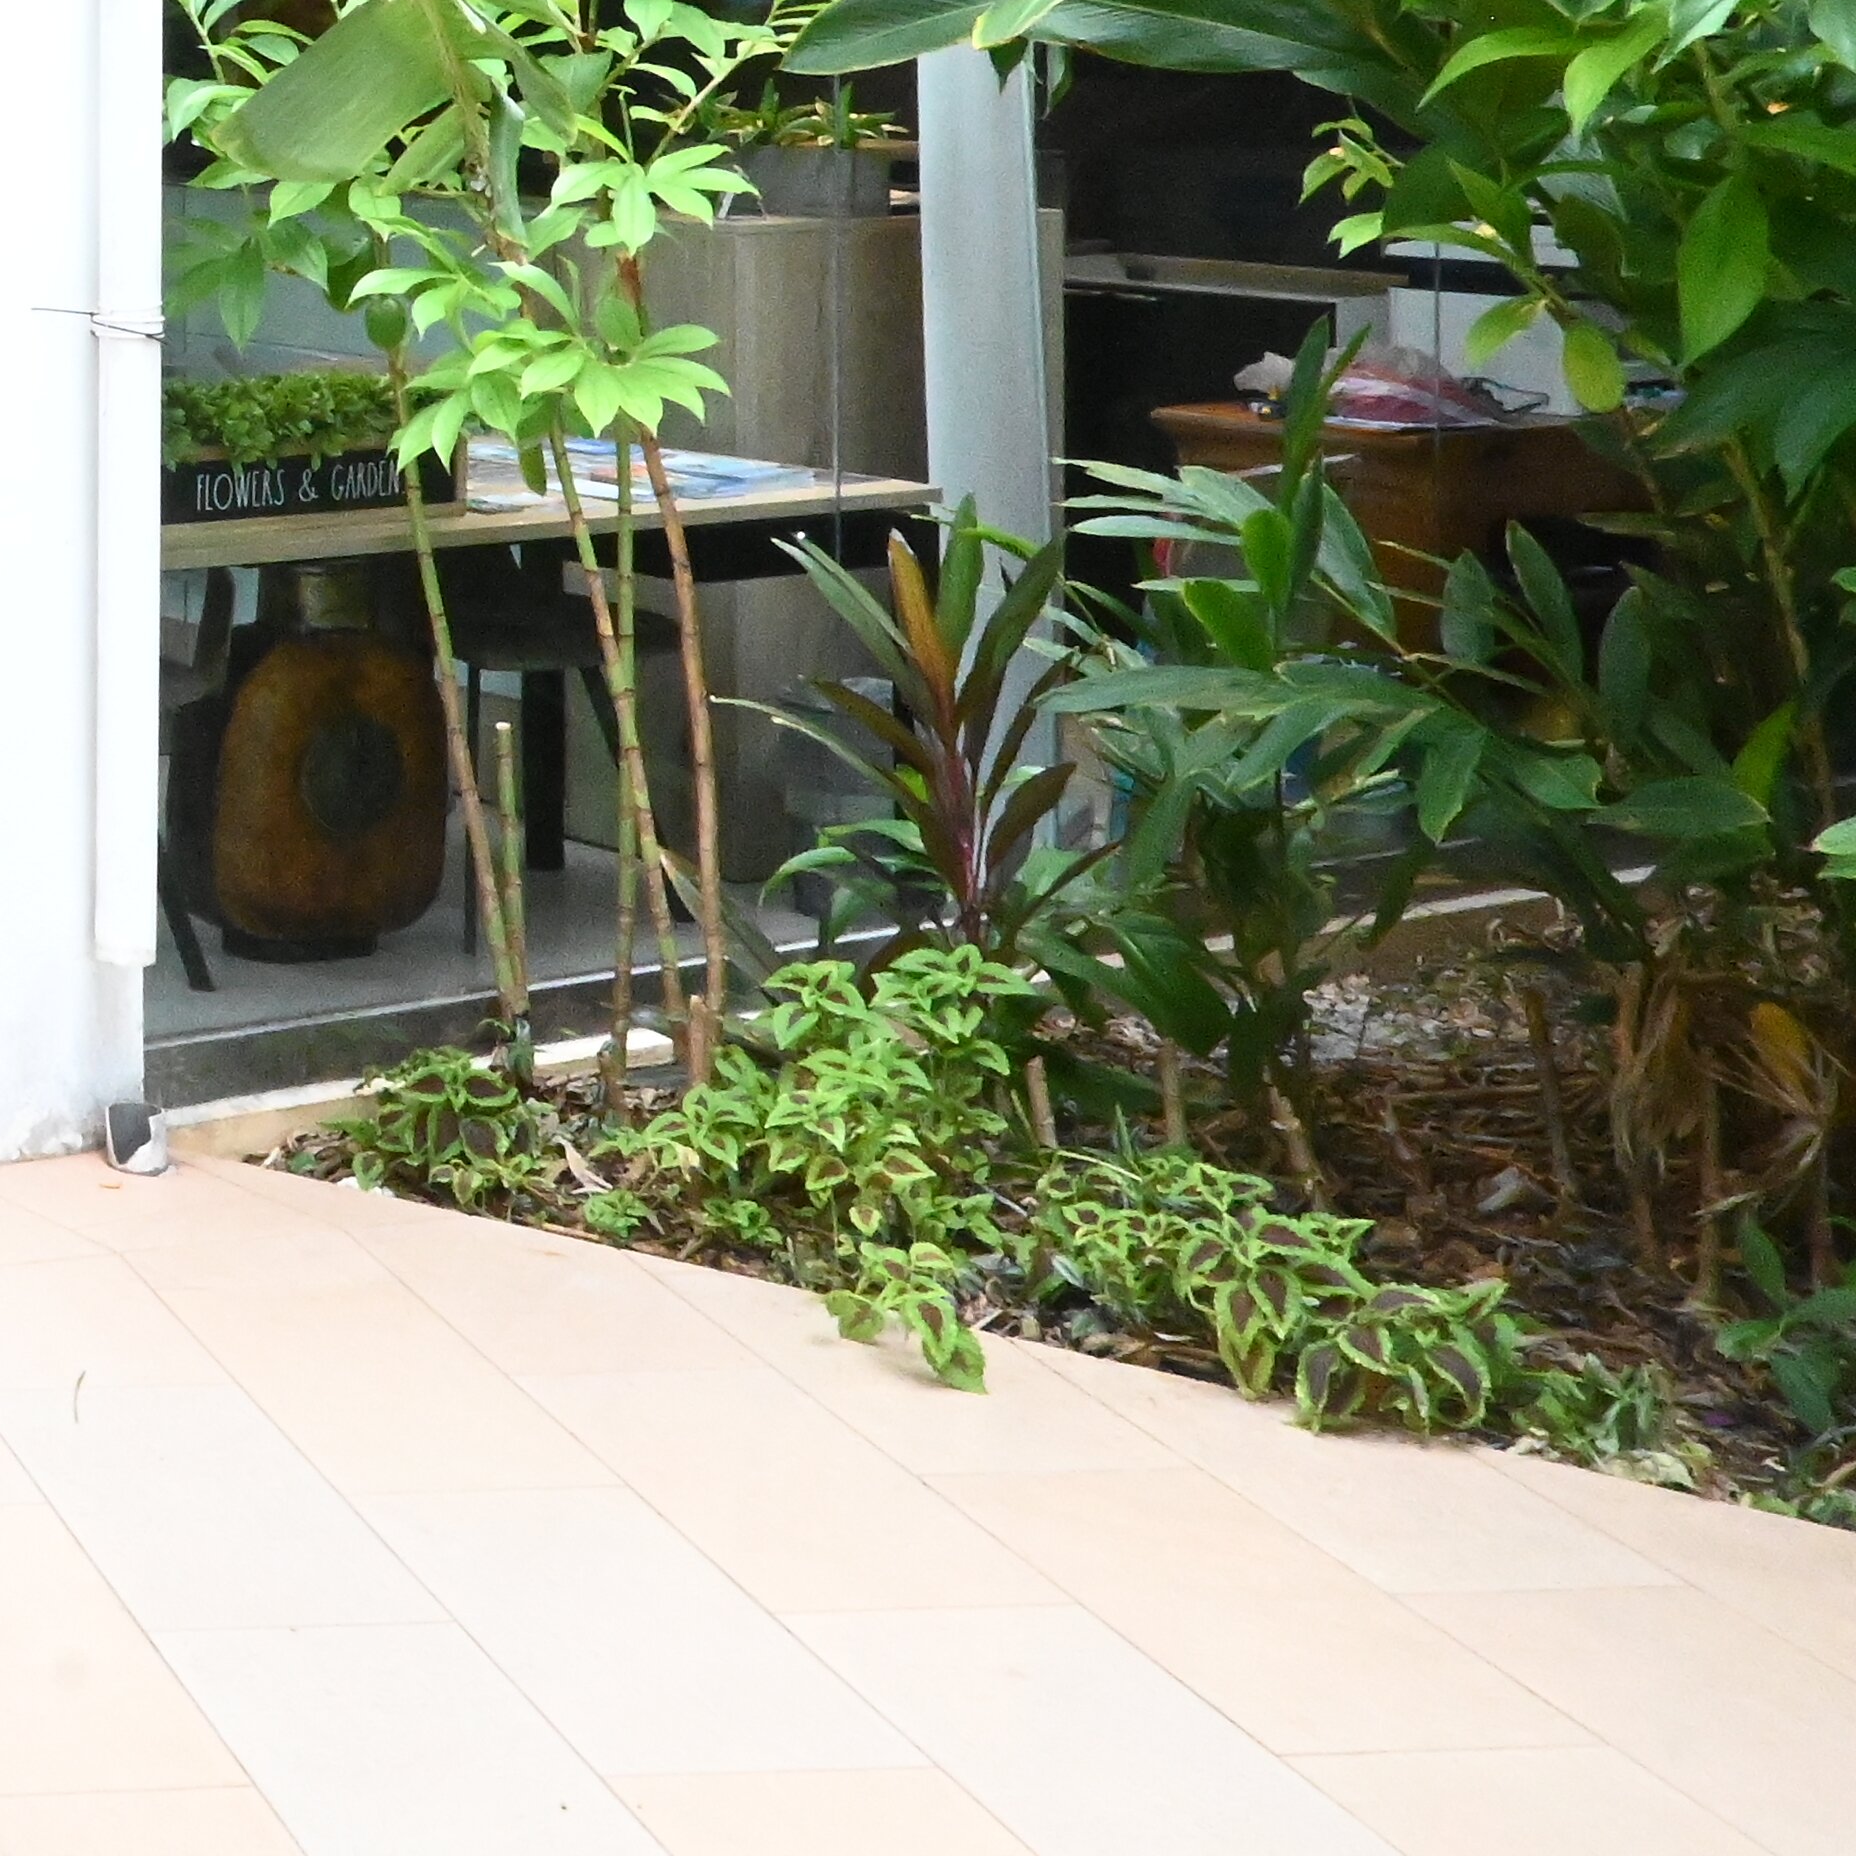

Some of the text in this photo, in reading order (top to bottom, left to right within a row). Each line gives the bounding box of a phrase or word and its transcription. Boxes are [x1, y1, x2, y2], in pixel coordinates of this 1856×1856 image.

[197, 459, 406, 511] FLOWERS & GARDEN
